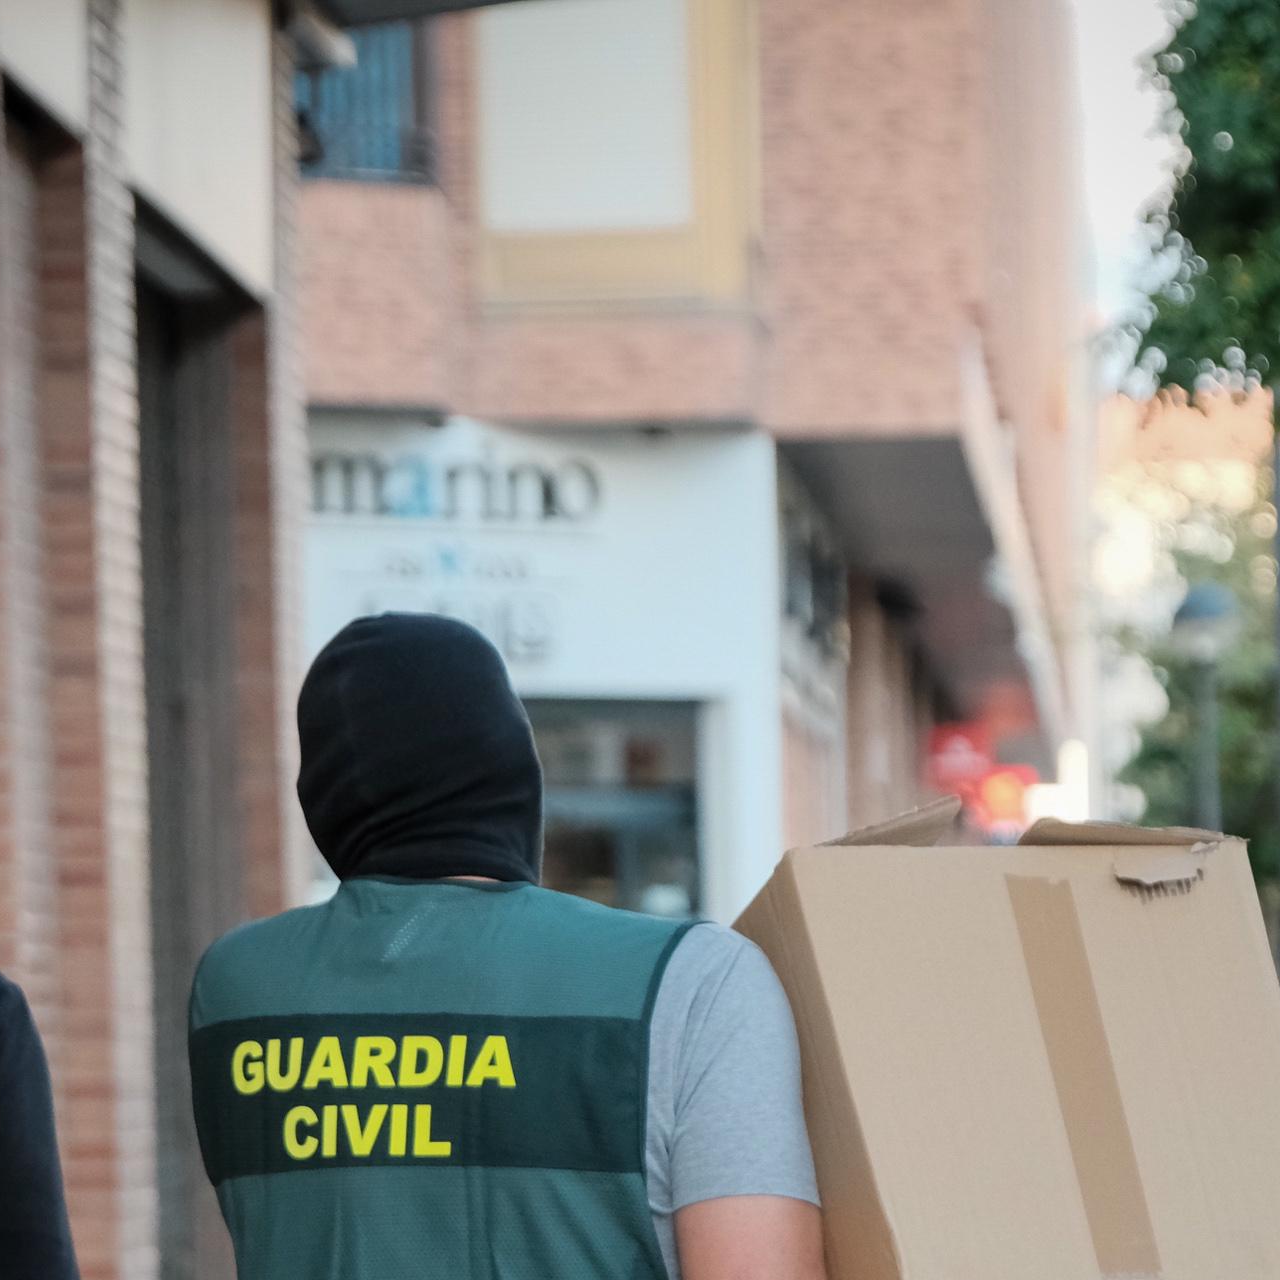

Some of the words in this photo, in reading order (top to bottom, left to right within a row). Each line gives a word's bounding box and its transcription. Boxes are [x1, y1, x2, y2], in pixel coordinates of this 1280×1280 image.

[309, 451, 601, 521] marino
[231, 1035, 516, 1095] GUARDIA
[282, 1103, 452, 1160] CIVIL
